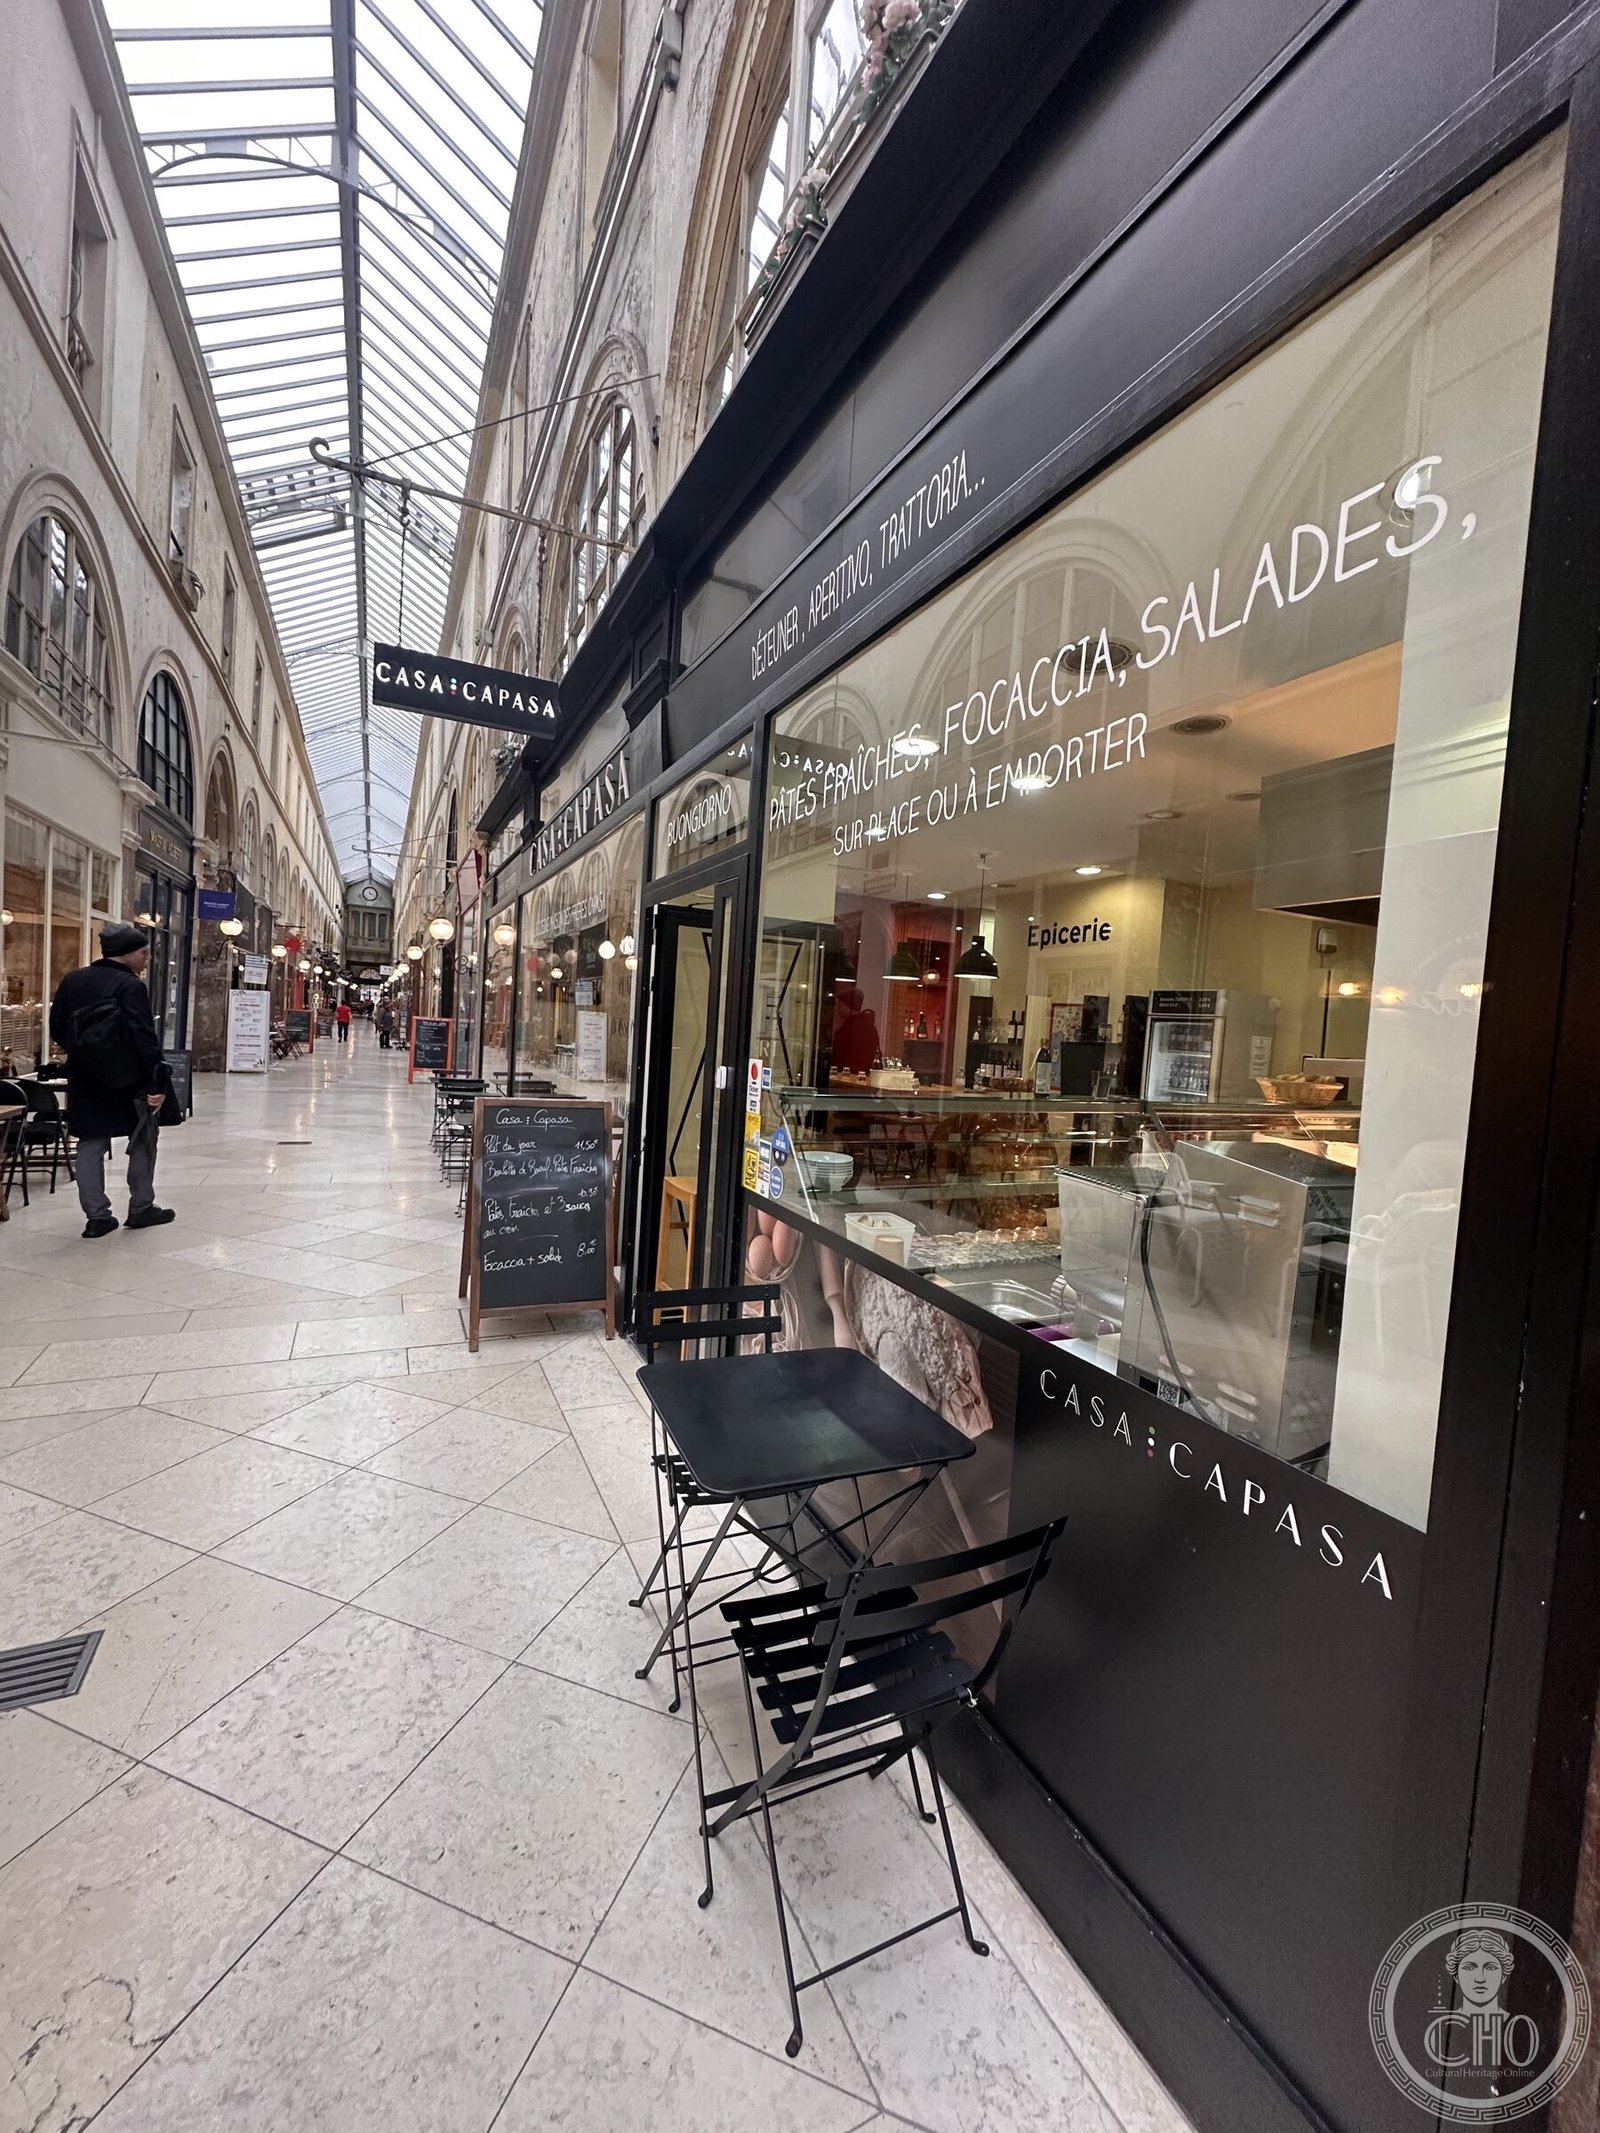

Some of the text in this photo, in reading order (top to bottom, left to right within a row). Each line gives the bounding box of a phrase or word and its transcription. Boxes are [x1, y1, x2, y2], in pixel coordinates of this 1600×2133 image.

[808, 539, 873, 632] APERITIVO,
[879, 449, 985, 569] TRATTORIA...
[375, 661, 556, 719] CASA CAPASA
[769, 455, 1476, 832] PÂTES FRAÎCHES, FOCACCIA, SALADES,
[528, 749, 630, 877] CASA CAPASA
[667, 784, 732, 847] BUONGIORNO
[833, 712, 1148, 857] SUR PLACE OU À EMPORTER
[1027, 917, 1112, 951] Epicerie
[496, 1108, 573, 1132] Casa Capasa
[557, 1196, 566, 1212] 3
[1039, 1369, 1393, 1601] CASA CAPASA
